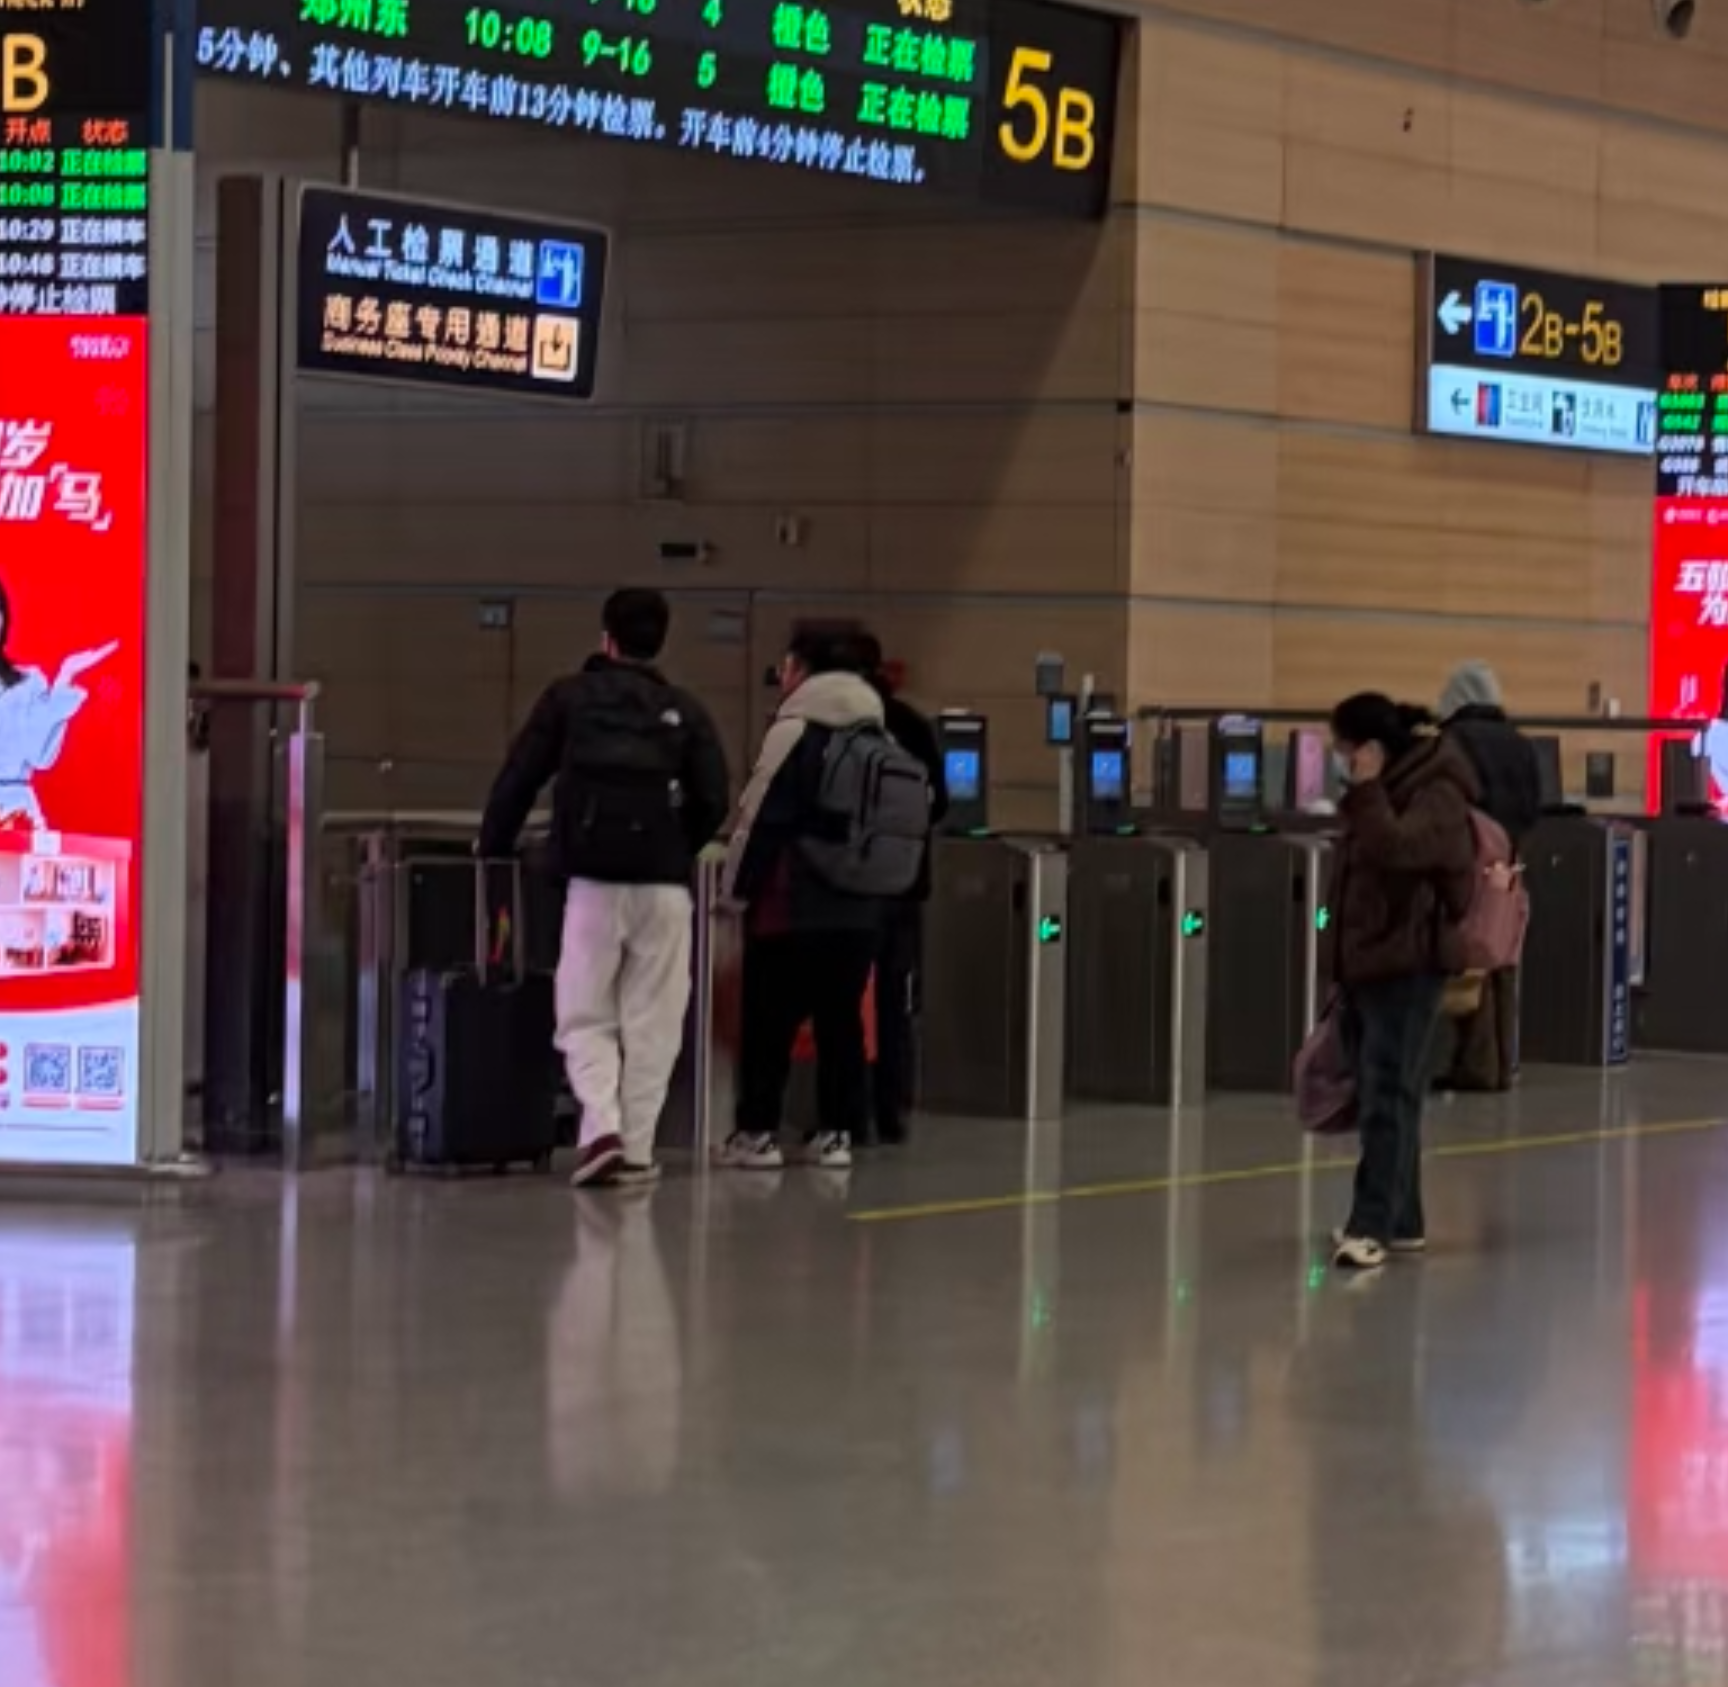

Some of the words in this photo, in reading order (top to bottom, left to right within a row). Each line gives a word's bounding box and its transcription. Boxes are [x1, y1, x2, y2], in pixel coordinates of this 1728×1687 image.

[0, 33, 50, 112] B
[465, 8, 553, 58] 10:08
[582, 29, 652, 76] 9-16
[697, 52, 717, 88] 5
[767, 61, 825, 113] 橙色
[856, 81, 970, 139] 正在检票
[772, 2, 831, 54] 橙色
[863, 23, 976, 82] 正在检票
[999, 46, 1096, 170] 5B
[326, 213, 534, 278] 人工检票通道
[1520, 292, 1623, 366] 2B-5B
[0, 418, 53, 468] 岁
